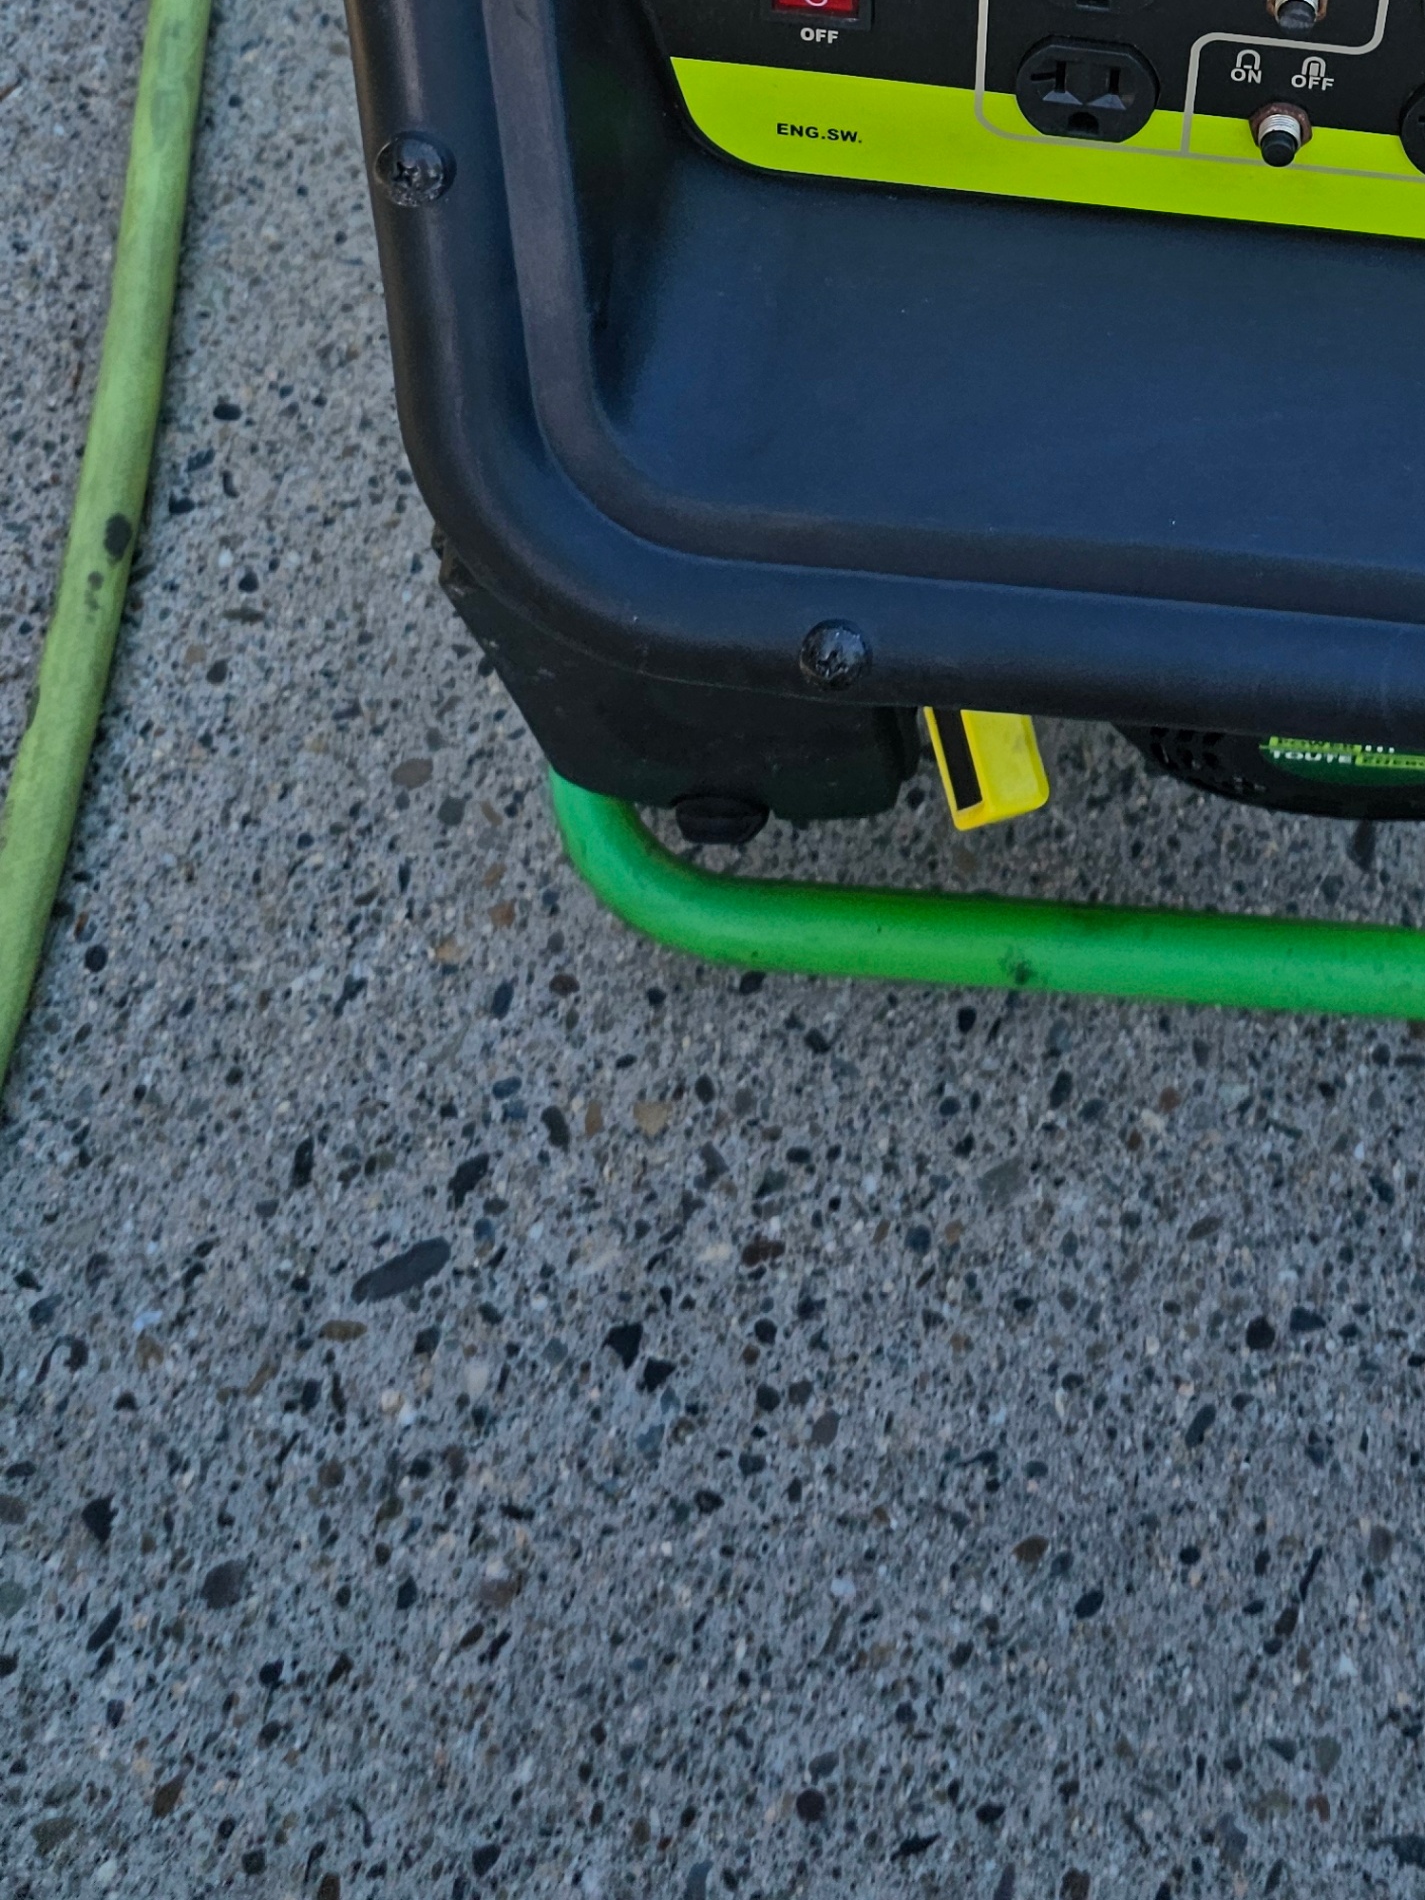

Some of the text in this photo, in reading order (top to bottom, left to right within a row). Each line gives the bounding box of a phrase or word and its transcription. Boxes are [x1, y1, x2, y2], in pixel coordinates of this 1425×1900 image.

[800, 27, 839, 44] OFF
[1230, 67, 1335, 91] ON OFF
[776, 122, 862, 143] ENG.SW.
